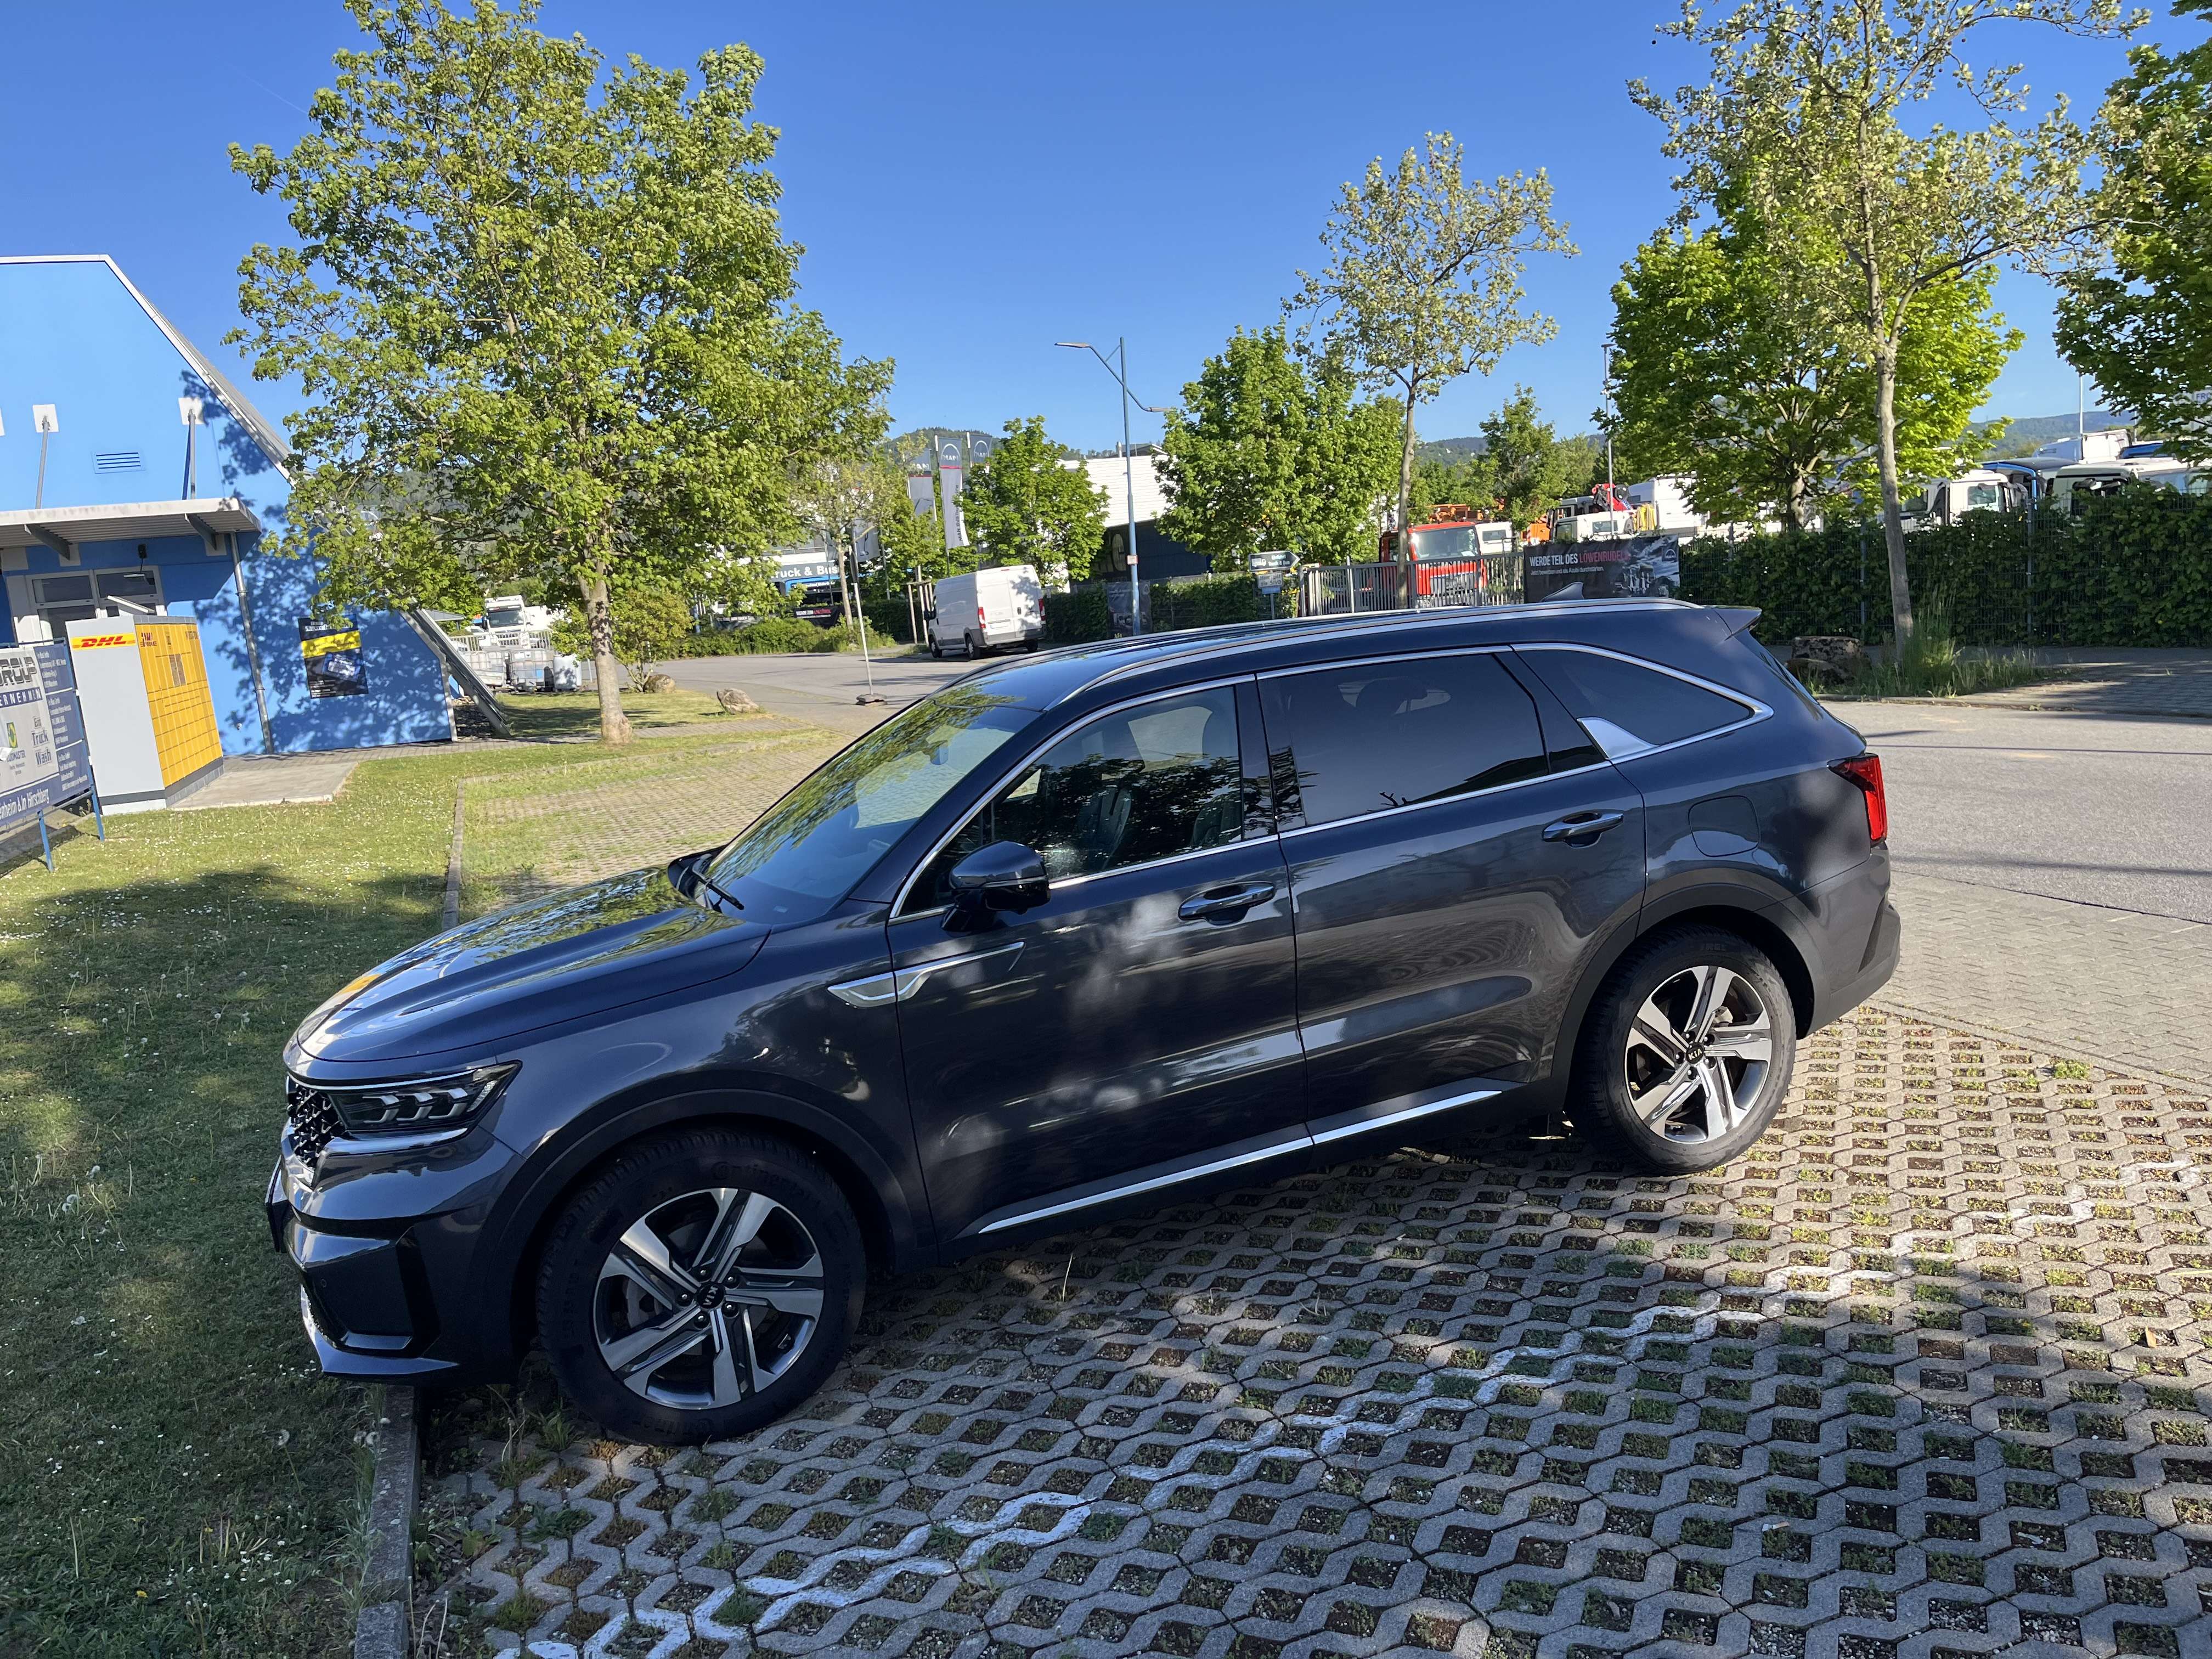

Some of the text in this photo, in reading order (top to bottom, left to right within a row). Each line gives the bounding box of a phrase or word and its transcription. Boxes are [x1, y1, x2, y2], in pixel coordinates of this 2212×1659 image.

[1530, 555, 1550, 567] WERDE
[1551, 554, 1565, 565] TEIL
[1565, 553, 1578, 565] DES
[804, 566, 813, 576] &
[816, 565, 838, 575] Bus
[81, 636, 127, 648] DHL
[31, 729, 48, 746] Truck
[35, 749, 52, 765] Wash
[1688, 1048, 1703, 1060] KIA
[702, 1285, 719, 1306] KIA
